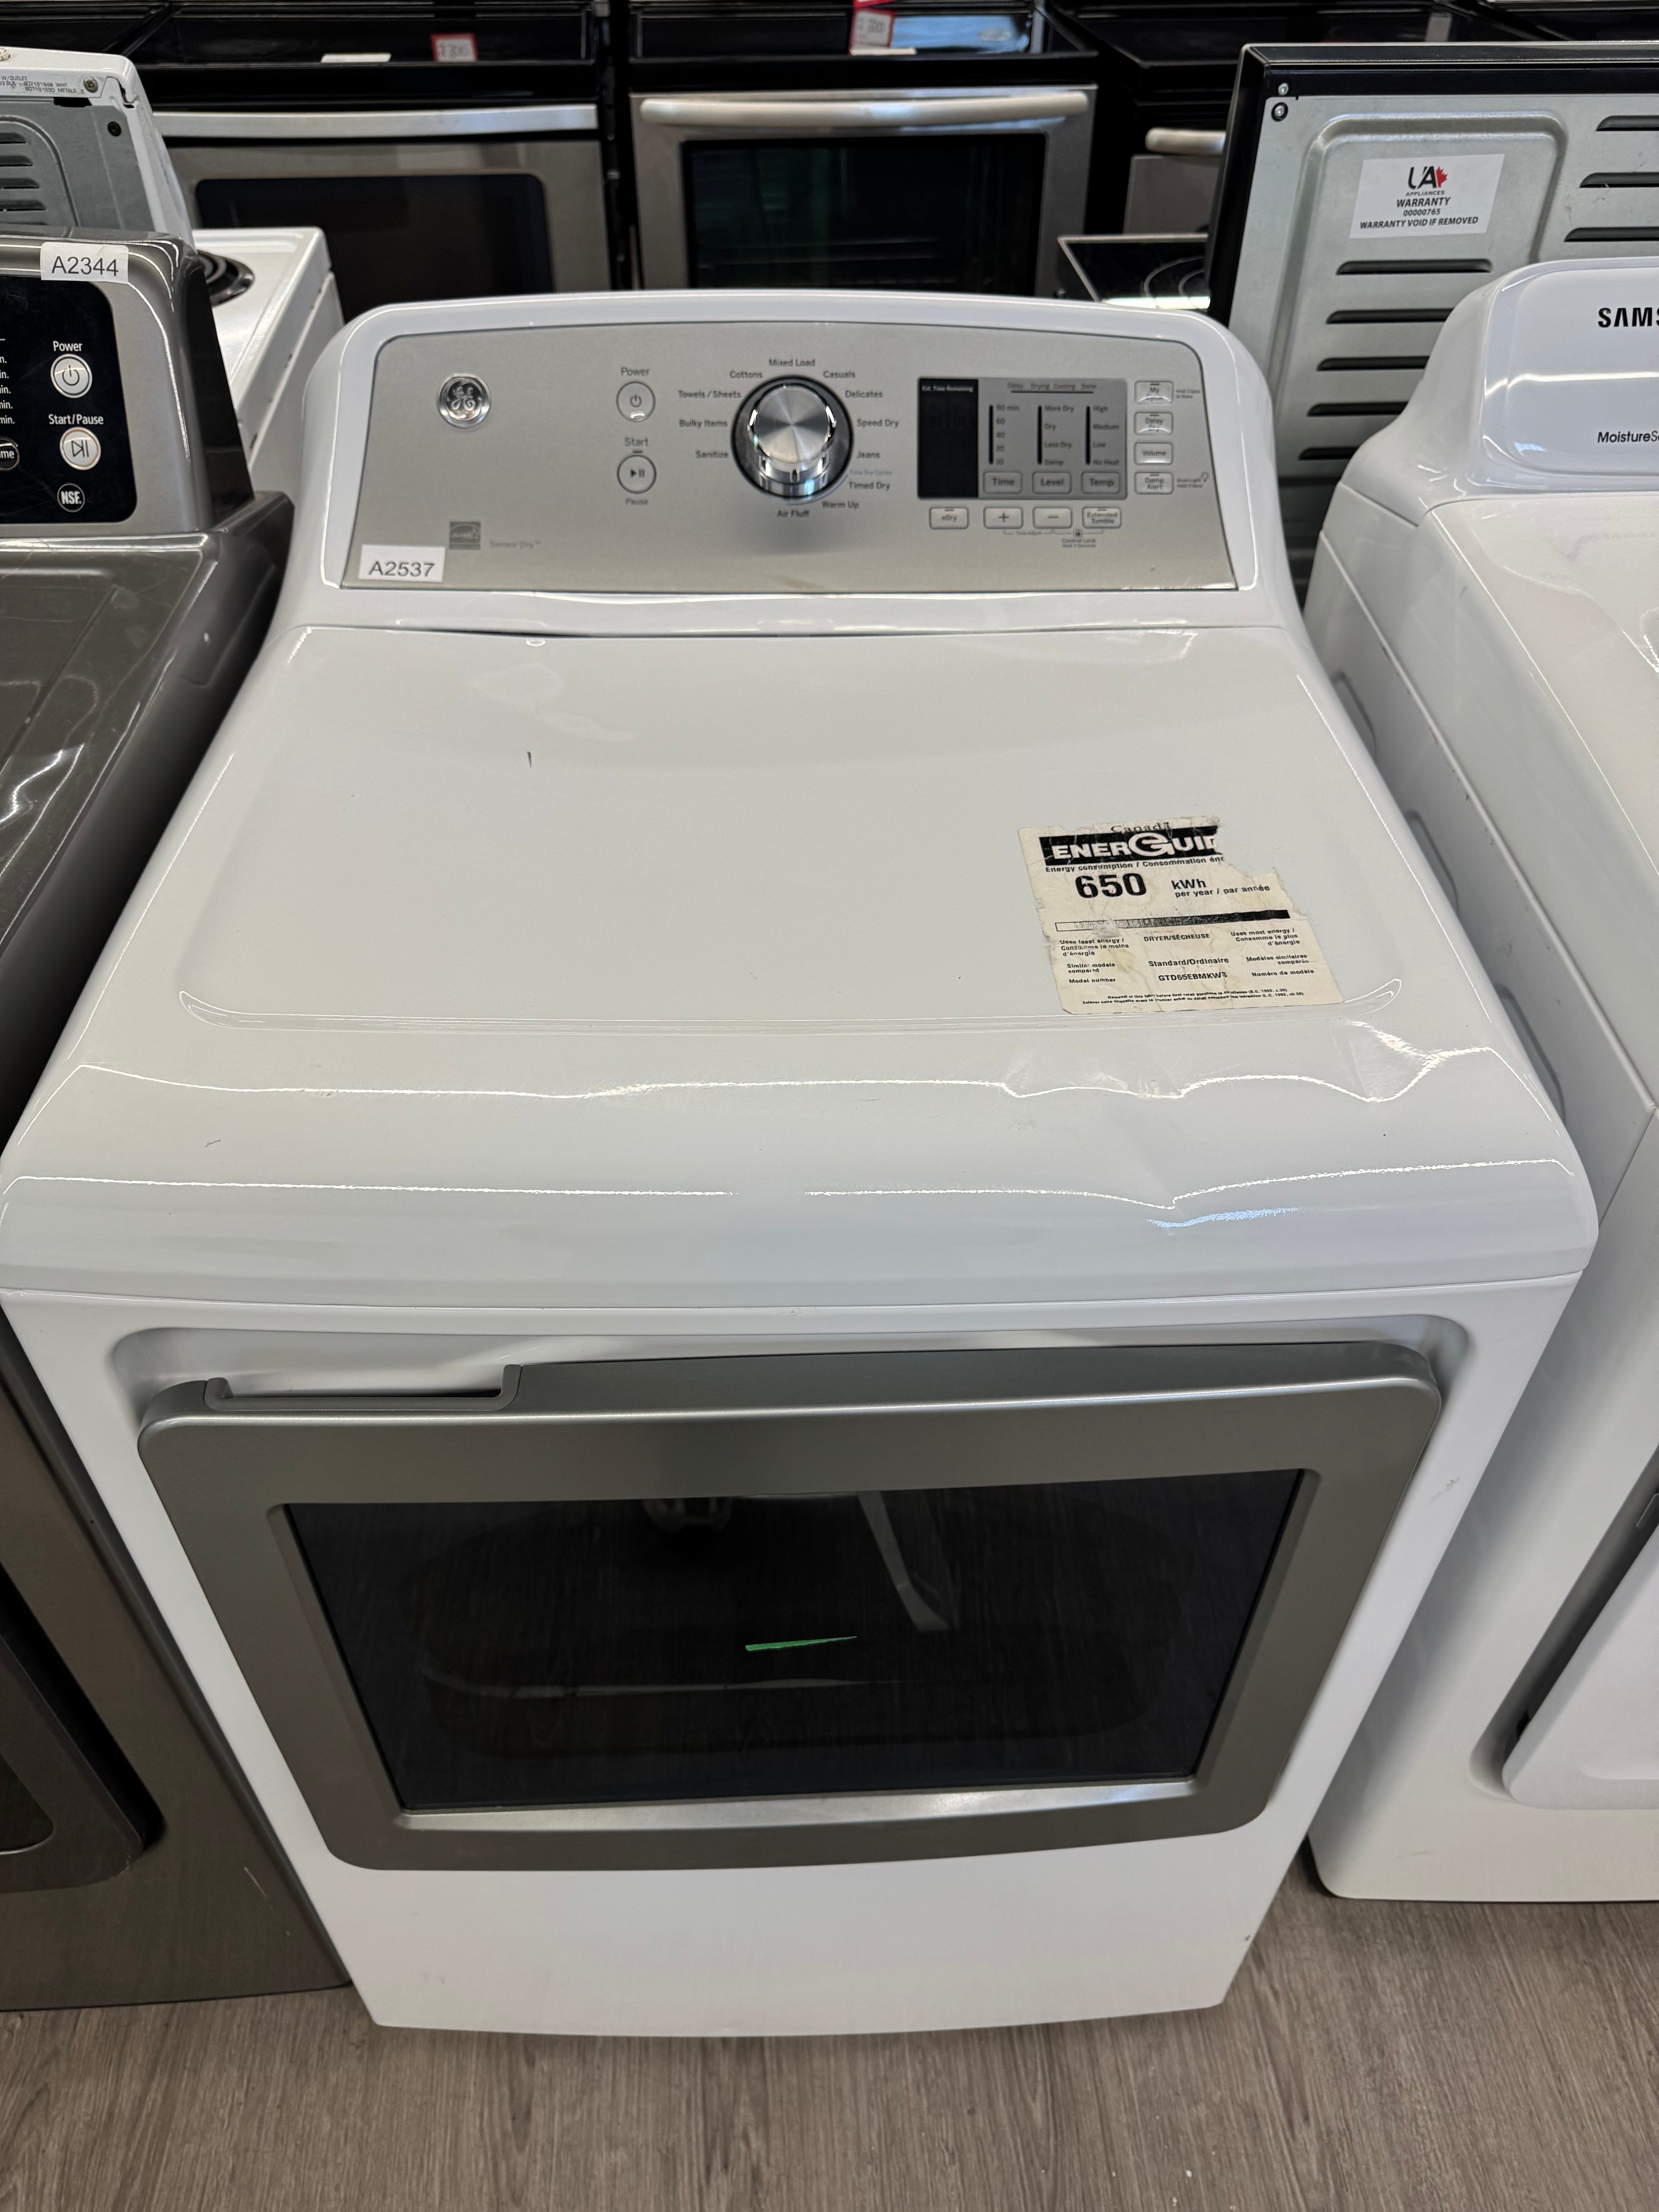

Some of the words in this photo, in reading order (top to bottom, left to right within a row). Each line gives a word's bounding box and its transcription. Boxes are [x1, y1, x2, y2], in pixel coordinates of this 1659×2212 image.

[1396, 197, 1451, 207] WARRANTY
[1360, 219, 1406, 229] WARRANTY
[1408, 218, 1428, 227] VOID
[1429, 218, 1437, 226] IF
[1438, 216, 1479, 226] REMOVED
[51, 256, 119, 276] A2344
[1598, 307, 1659, 328] SAM
[53, 340, 83, 352] Power
[621, 367, 650, 376] Power
[729, 371, 763, 379] Cottons
[0, 384, 11, 394] in.
[48, 413, 104, 425] Start/Pause
[857, 419, 883, 429] Speed
[885, 419, 899, 429] Dry
[679, 420, 702, 429] Bulky
[705, 420, 728, 428] Items
[1597, 430, 1659, 443] MoistureS
[624, 438, 648, 447] Start
[696, 451, 729, 459] Sanitize
[876, 482, 891, 491] Dry
[1040, 478, 1065, 486] Level
[1089, 478, 1114, 487] Temp
[848, 501, 859, 509] Up
[369, 561, 435, 577] A2537
[1110, 822, 1171, 833] Canada
[1143, 857, 1207, 867] Consommation
[1075, 873, 1147, 899] 650
[1171, 879, 1207, 890] kWh
[1193, 889, 1213, 897] year
[1241, 884, 1271, 893] année
[1144, 933, 1210, 942] DRYER/SÉCHEUSE
[1148, 957, 1229, 967] Standard/Ordinaire
